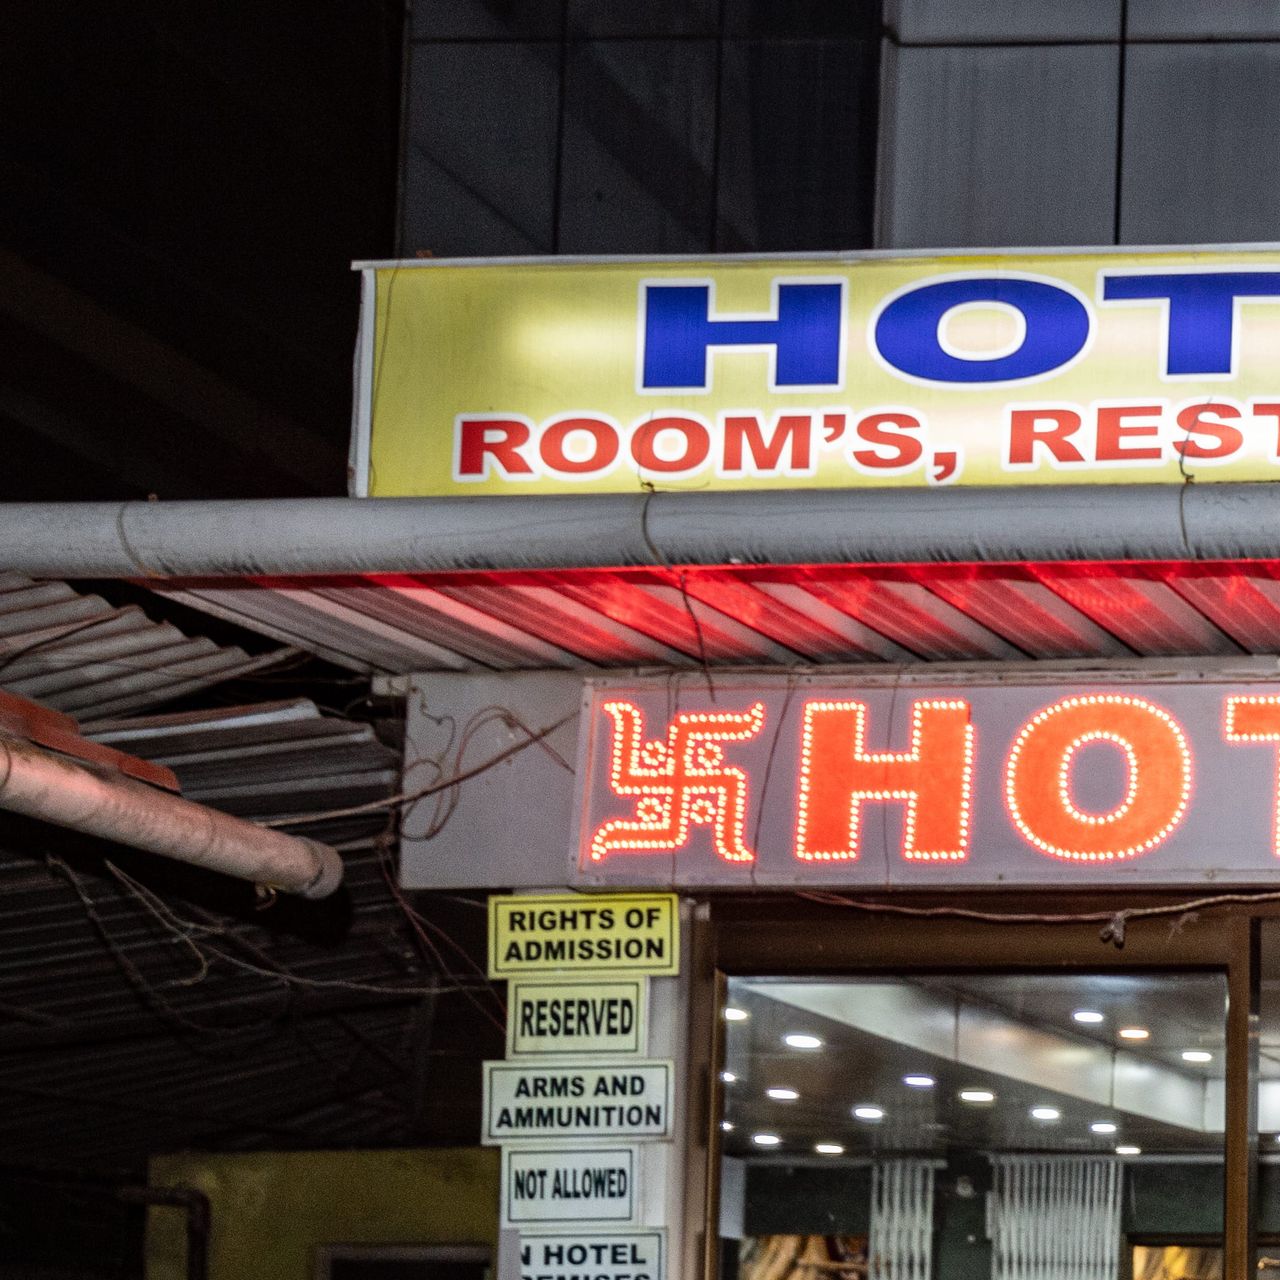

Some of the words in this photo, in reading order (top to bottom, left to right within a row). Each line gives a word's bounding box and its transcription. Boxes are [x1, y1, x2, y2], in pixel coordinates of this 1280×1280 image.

[459, 412, 957, 482] ROOM'S,
[509, 909, 615, 931] RIGHTS
[625, 908, 661, 929] OF
[504, 938, 664, 962] ADMISSION
[520, 998, 633, 1037] RESERVED
[515, 1076, 585, 1098] ARMS
[593, 1075, 645, 1096] AND
[496, 1105, 661, 1128] AMMUNITION
[514, 1169, 547, 1200] NOT
[552, 1168, 627, 1199] ALLOWED
[521, 1244, 531, 1266] N
[543, 1244, 646, 1265] HOTEL
